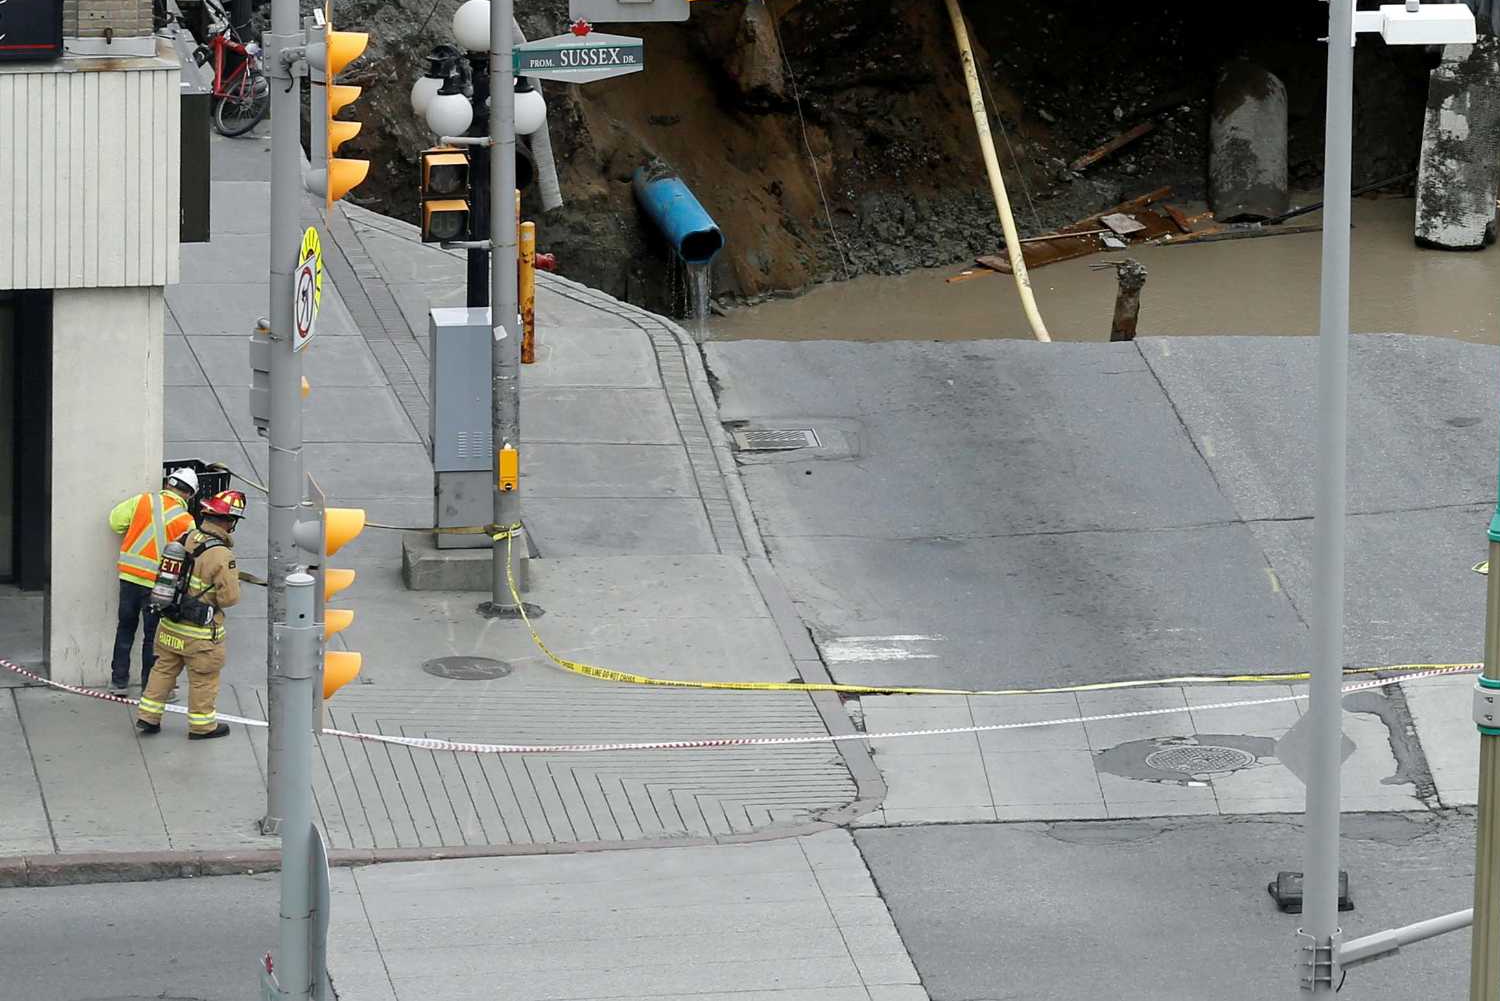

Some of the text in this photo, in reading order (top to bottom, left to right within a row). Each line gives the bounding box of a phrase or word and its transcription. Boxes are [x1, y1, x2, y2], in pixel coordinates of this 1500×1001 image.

[529, 47, 636, 68] PROM. SUSSEX DR.
